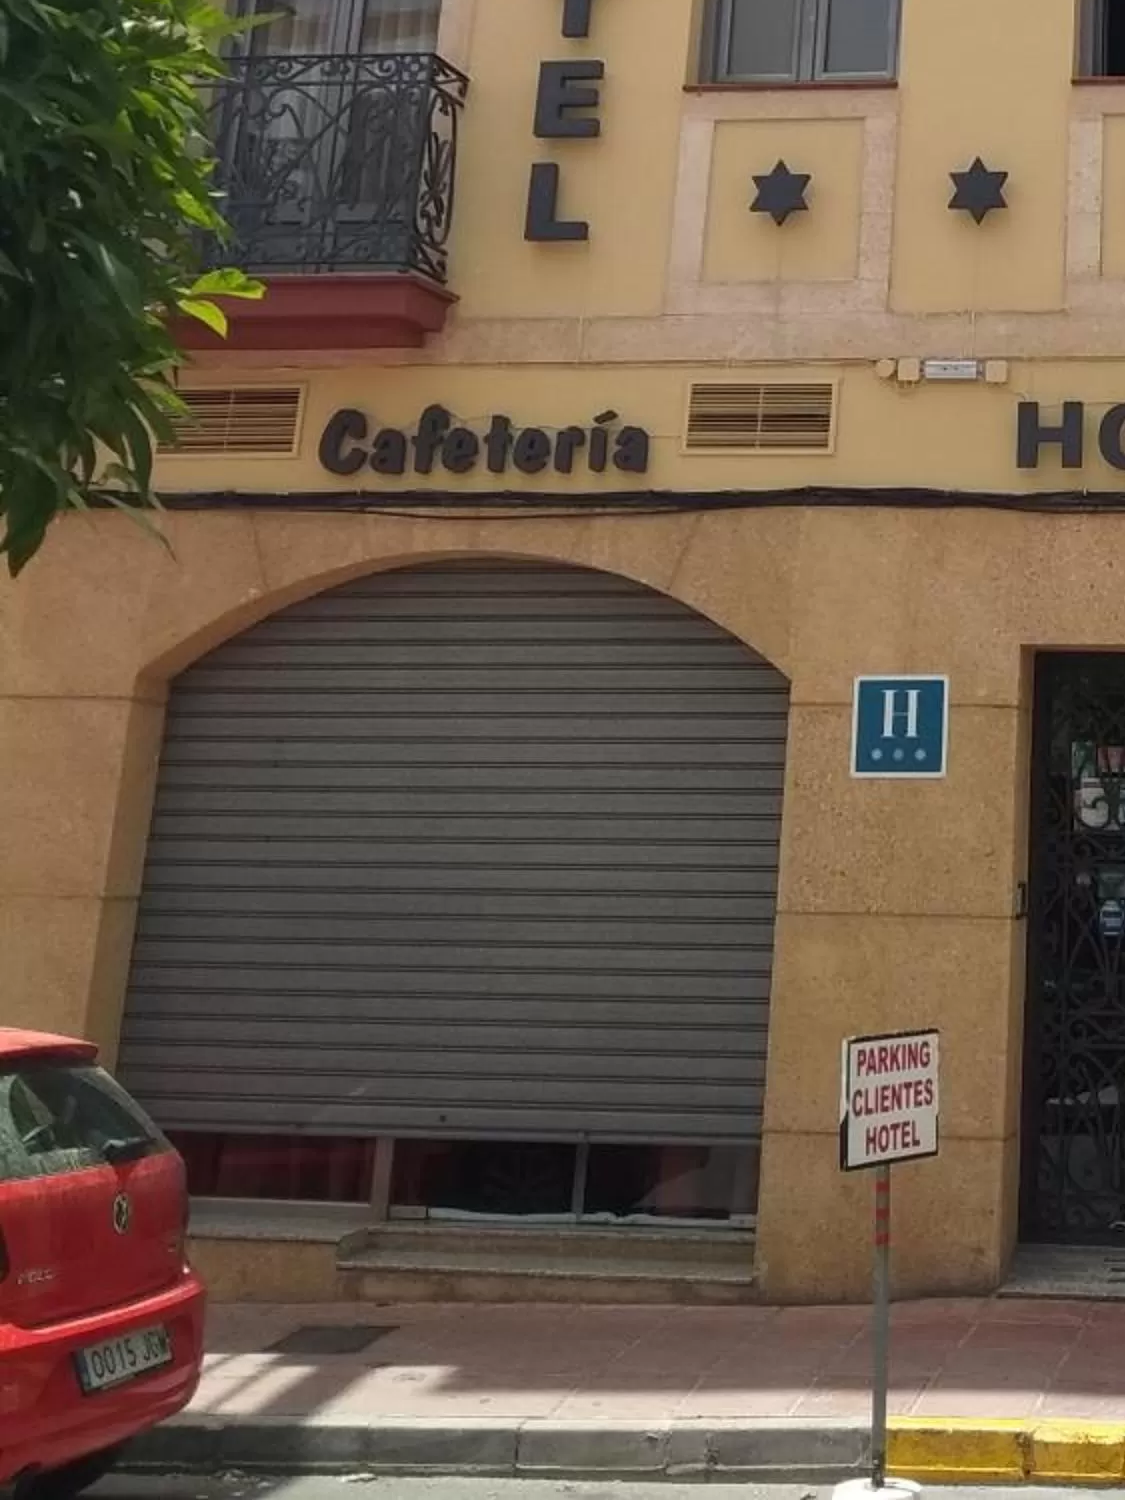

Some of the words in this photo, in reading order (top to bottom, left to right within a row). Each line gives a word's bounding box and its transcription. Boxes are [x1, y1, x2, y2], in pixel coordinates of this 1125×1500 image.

[317, 403, 651, 476] Cafetería
[880, 689, 922, 738] H
[857, 1041, 931, 1077] PARKING
[851, 1077, 934, 1118] CLIENTES
[865, 1120, 921, 1157] HOTEL
[91, 1338, 137, 1379] 0015
